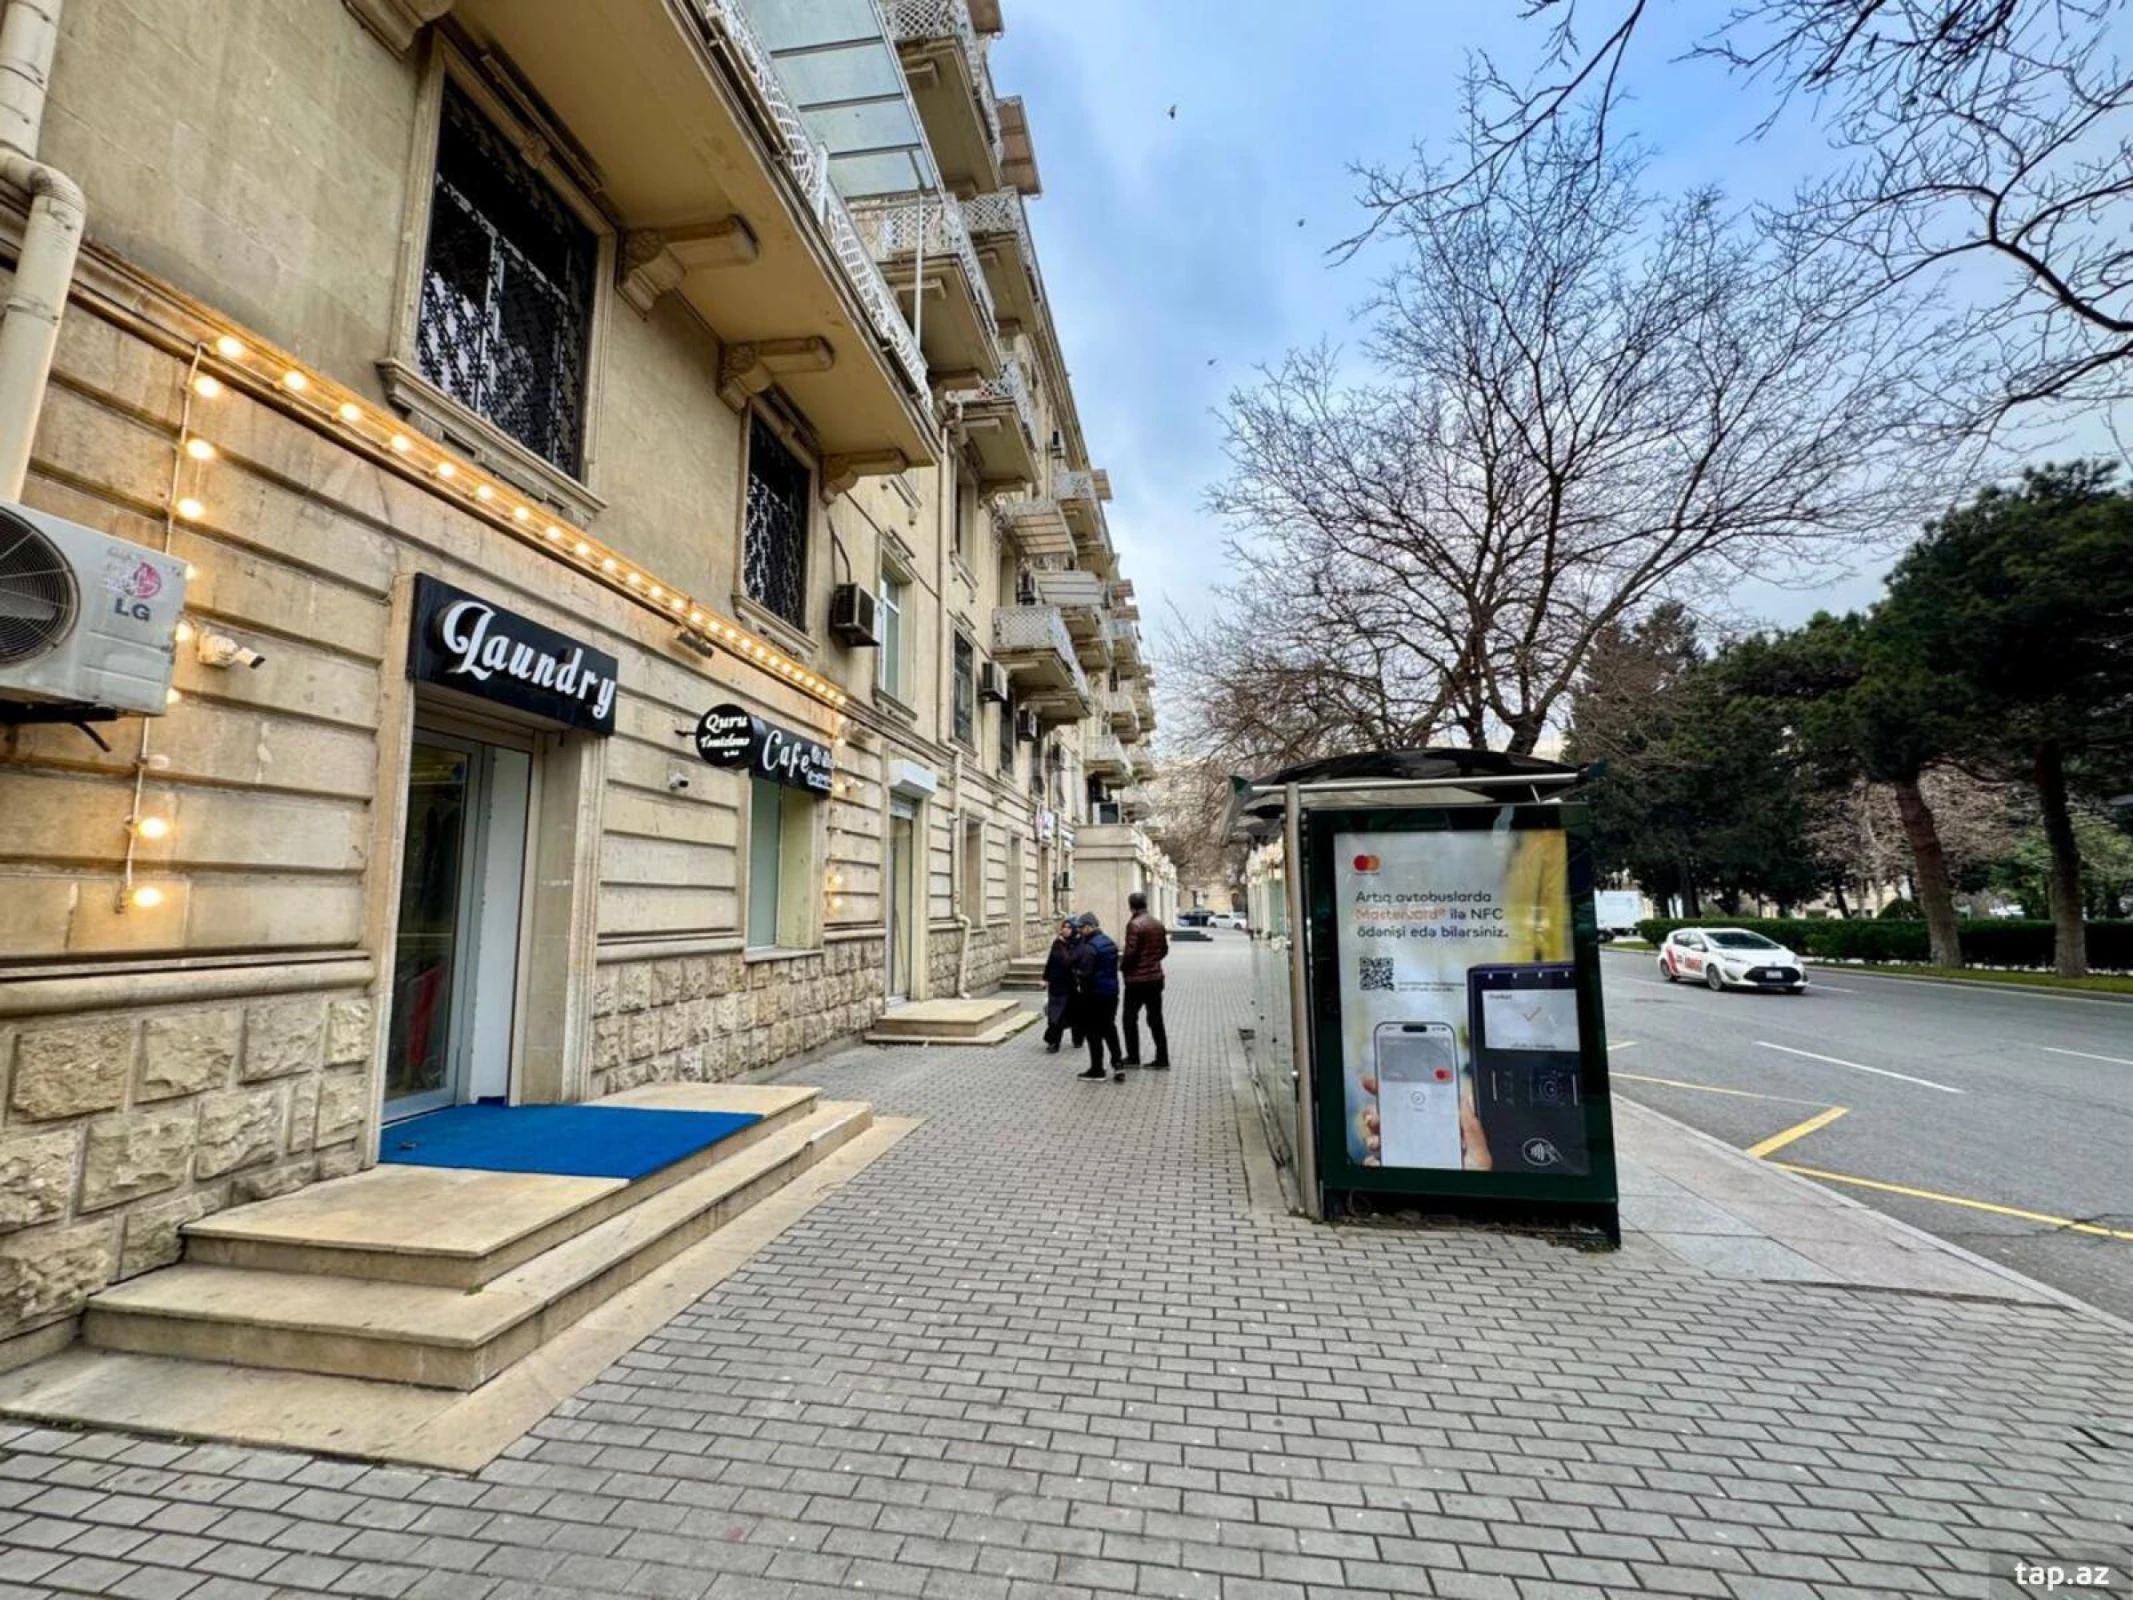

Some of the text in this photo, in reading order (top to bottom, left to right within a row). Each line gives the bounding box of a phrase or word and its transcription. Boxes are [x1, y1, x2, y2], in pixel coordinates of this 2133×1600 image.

[114, 597, 151, 622] LG
[442, 600, 616, 719] Laundry
[705, 714, 748, 733] Quru
[762, 729, 810, 778] Cafe
[1395, 890, 1492, 903] avtobuslarda
[1471, 908, 1504, 920] NFC
